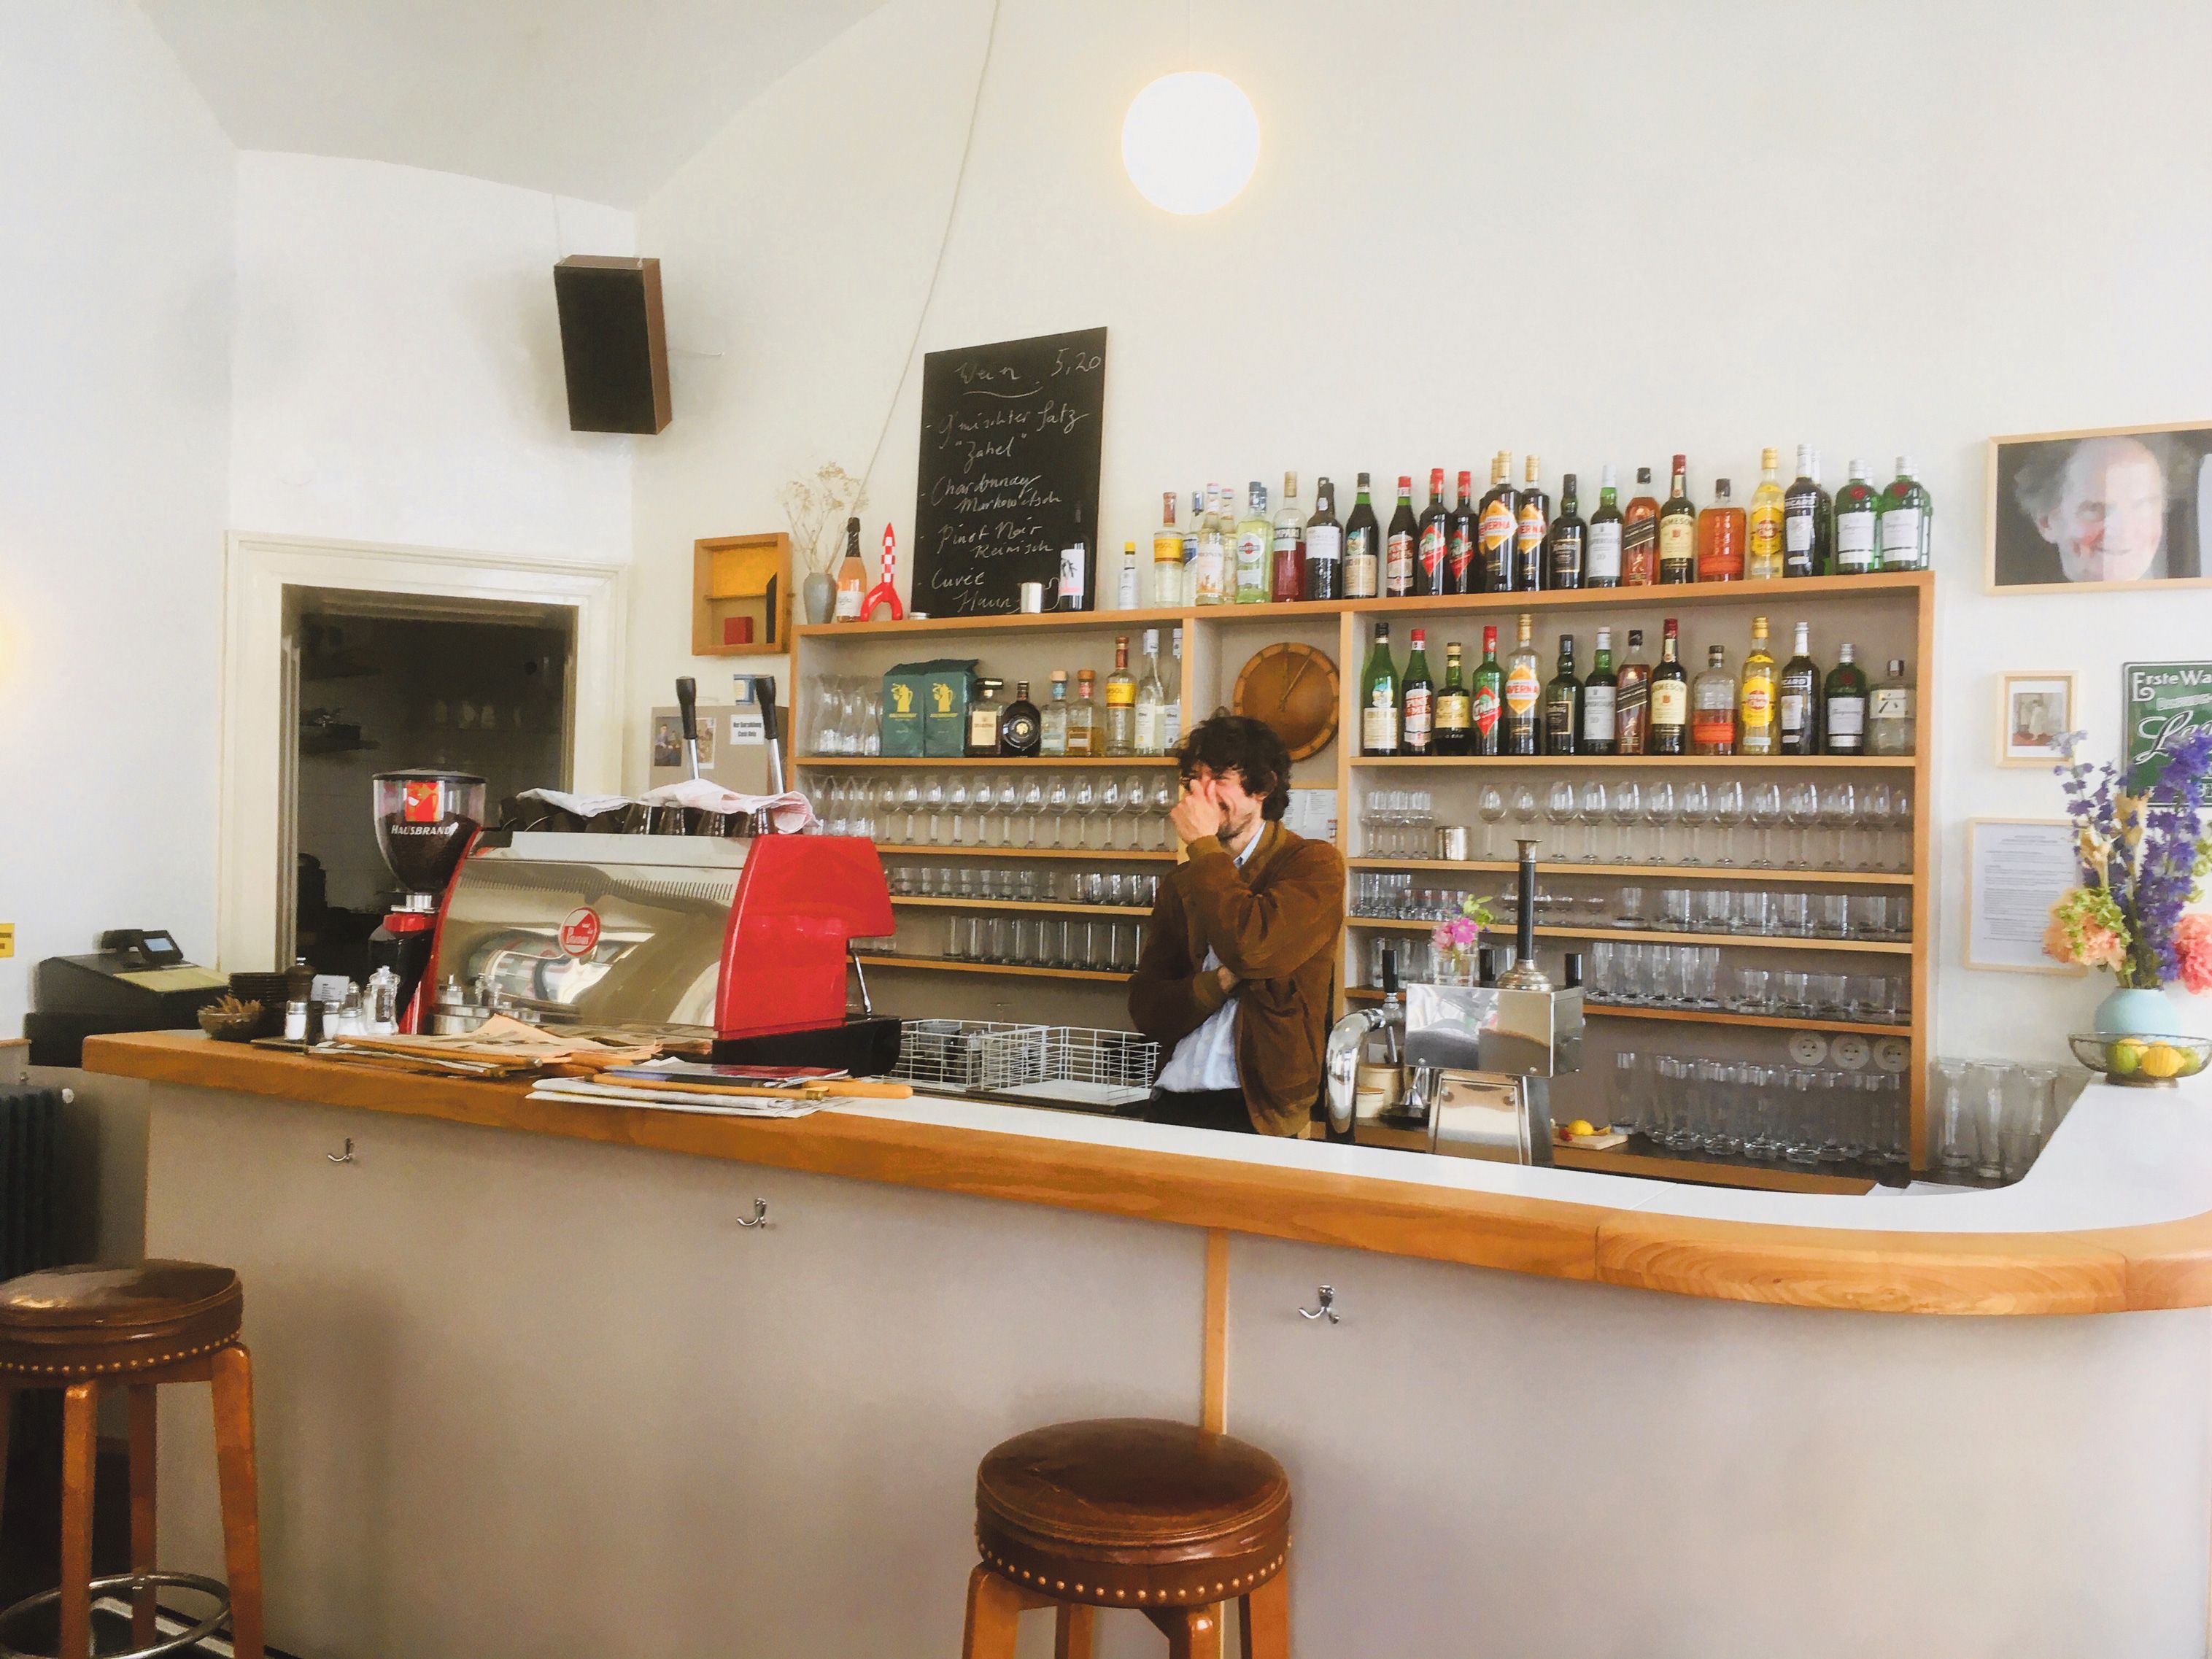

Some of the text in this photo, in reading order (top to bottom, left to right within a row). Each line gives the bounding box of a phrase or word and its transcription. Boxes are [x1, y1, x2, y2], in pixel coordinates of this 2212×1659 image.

[937, 522, 991, 554] Pinot
[2132, 670, 2179, 702] Erste
[391, 824, 454, 835] HAUSBRAND
